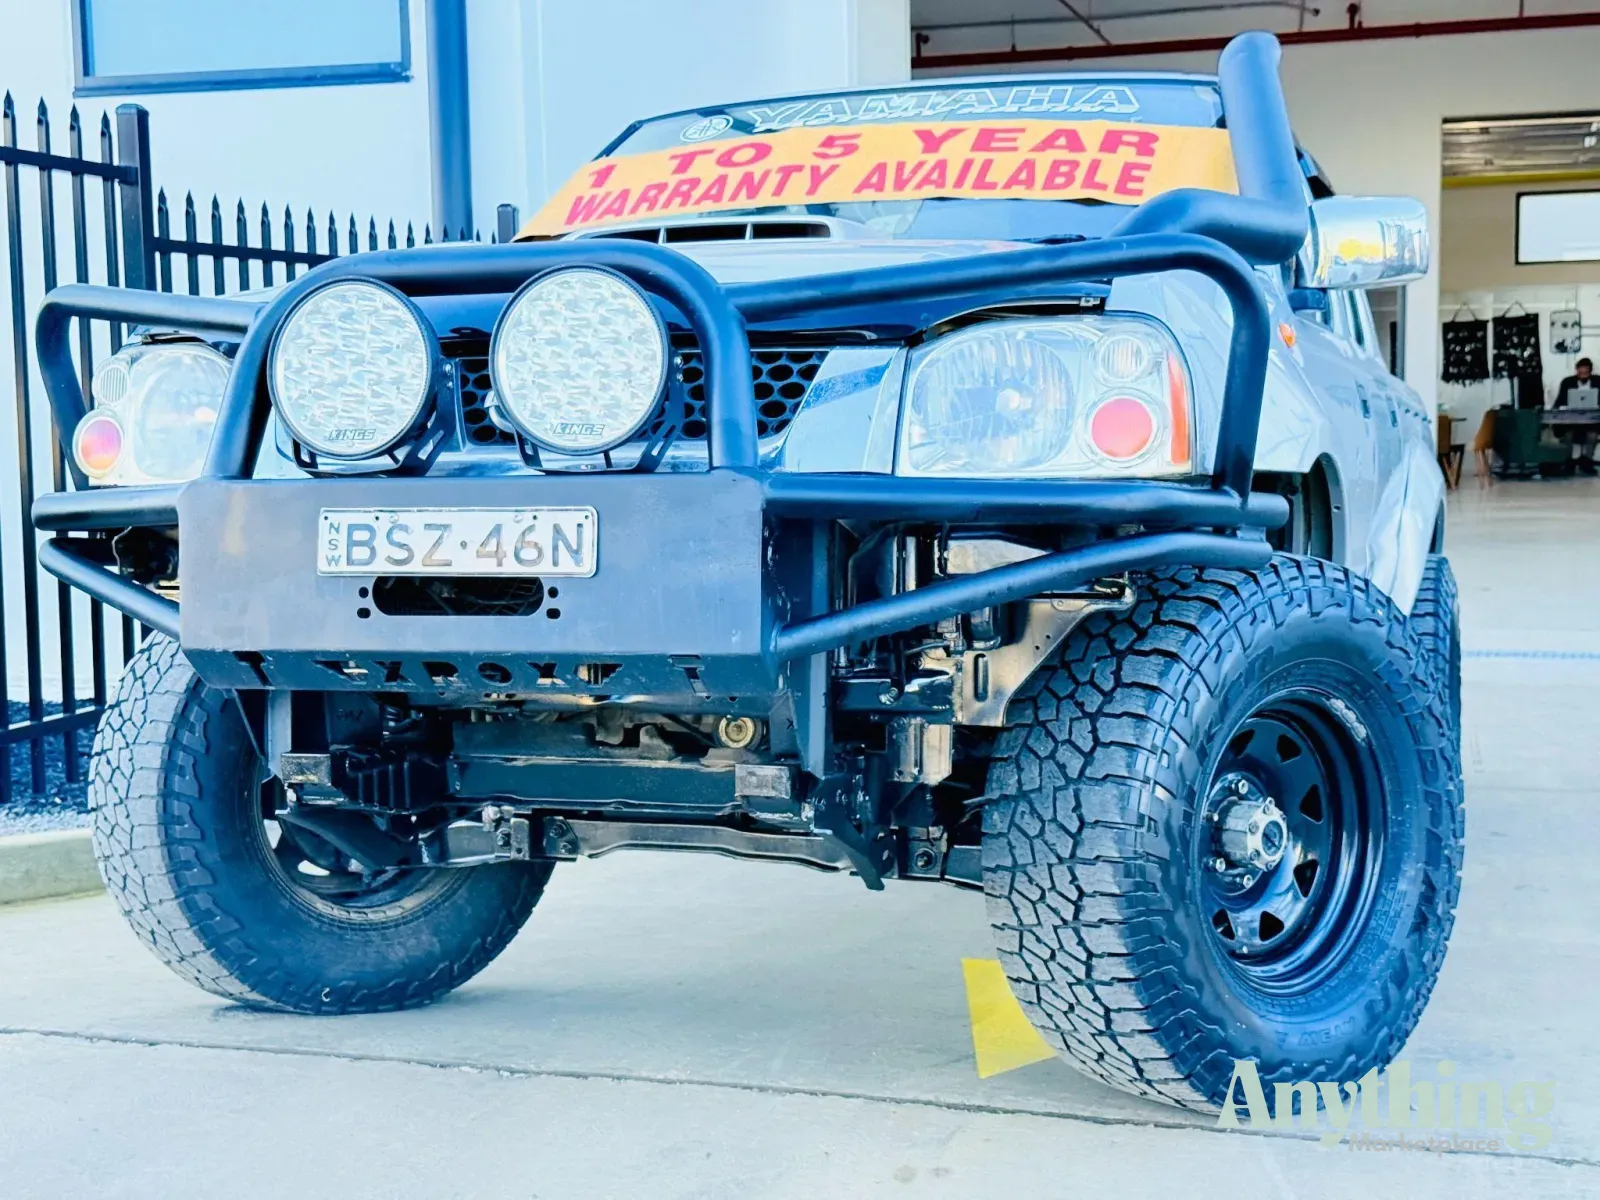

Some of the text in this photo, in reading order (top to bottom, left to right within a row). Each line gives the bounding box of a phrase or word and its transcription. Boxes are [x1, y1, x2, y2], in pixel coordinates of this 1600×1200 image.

[748, 85, 1140, 133] YAMAHA
[588, 128, 1160, 188] 1 TO 5 YEAR
[563, 157, 1153, 226] WARRANTY AVAILABLE
[328, 428, 376, 441] KINGS
[553, 422, 606, 436] KINGS
